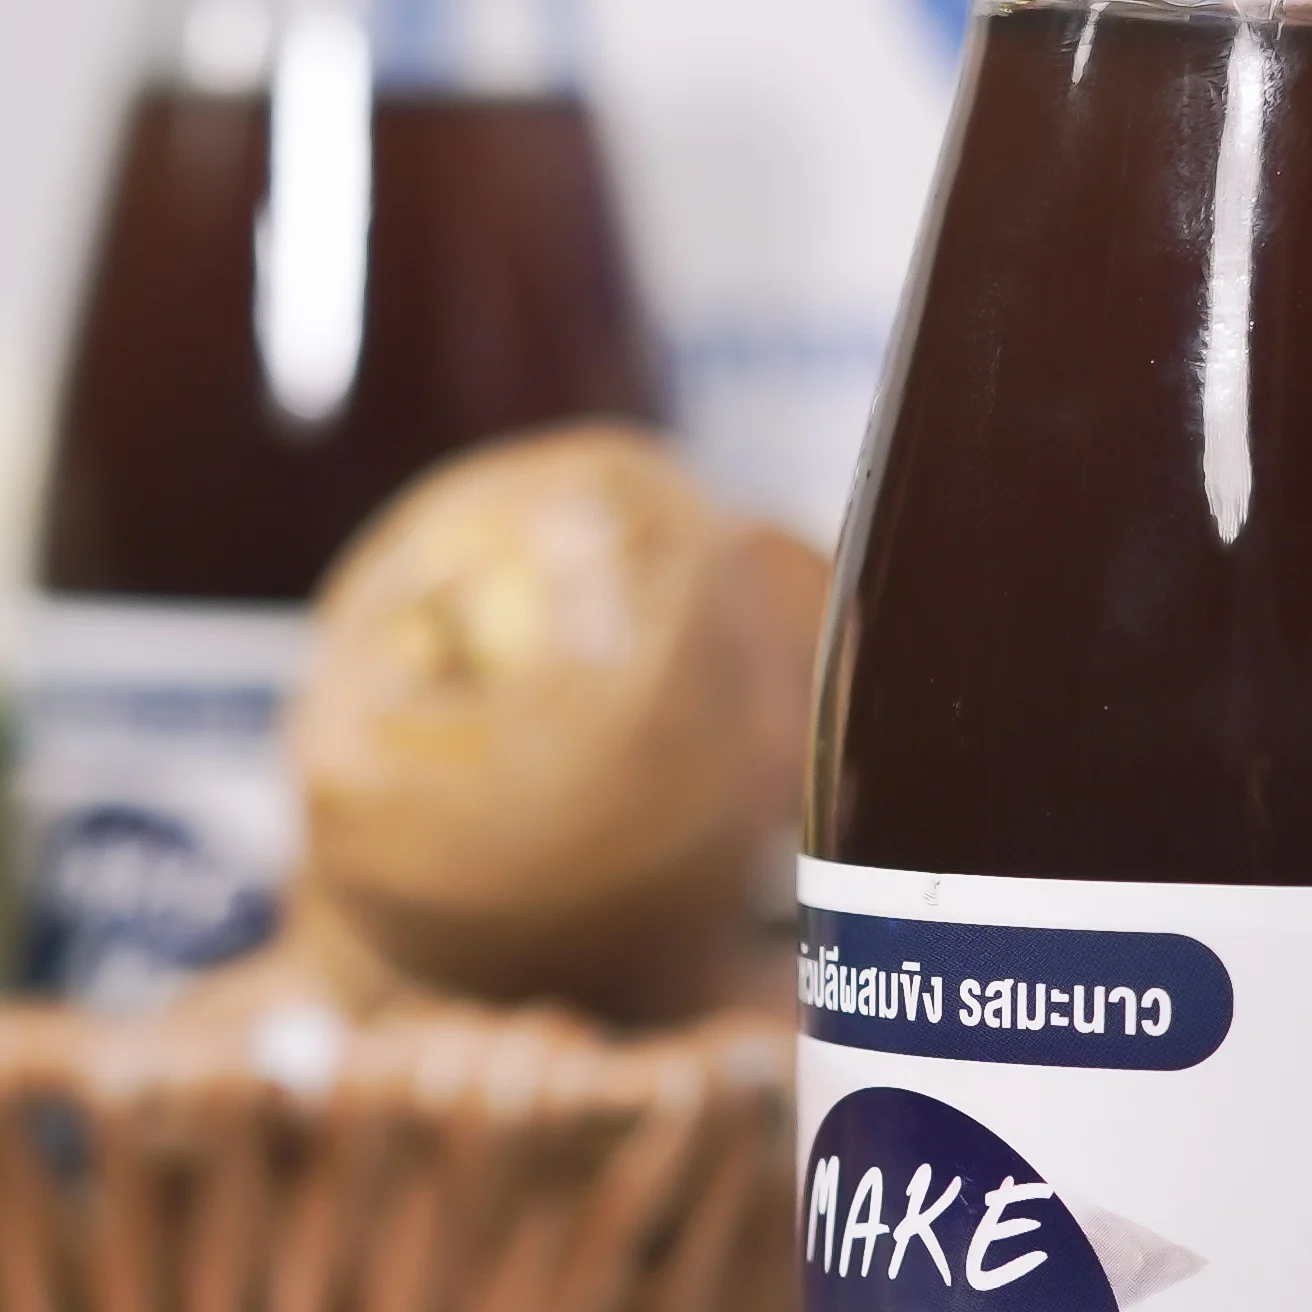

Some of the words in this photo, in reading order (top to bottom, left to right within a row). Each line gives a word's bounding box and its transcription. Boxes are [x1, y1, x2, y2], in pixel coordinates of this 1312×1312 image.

[959, 978, 1173, 1037] รสมะนาว
[805, 1156, 1055, 1291] MAKE
